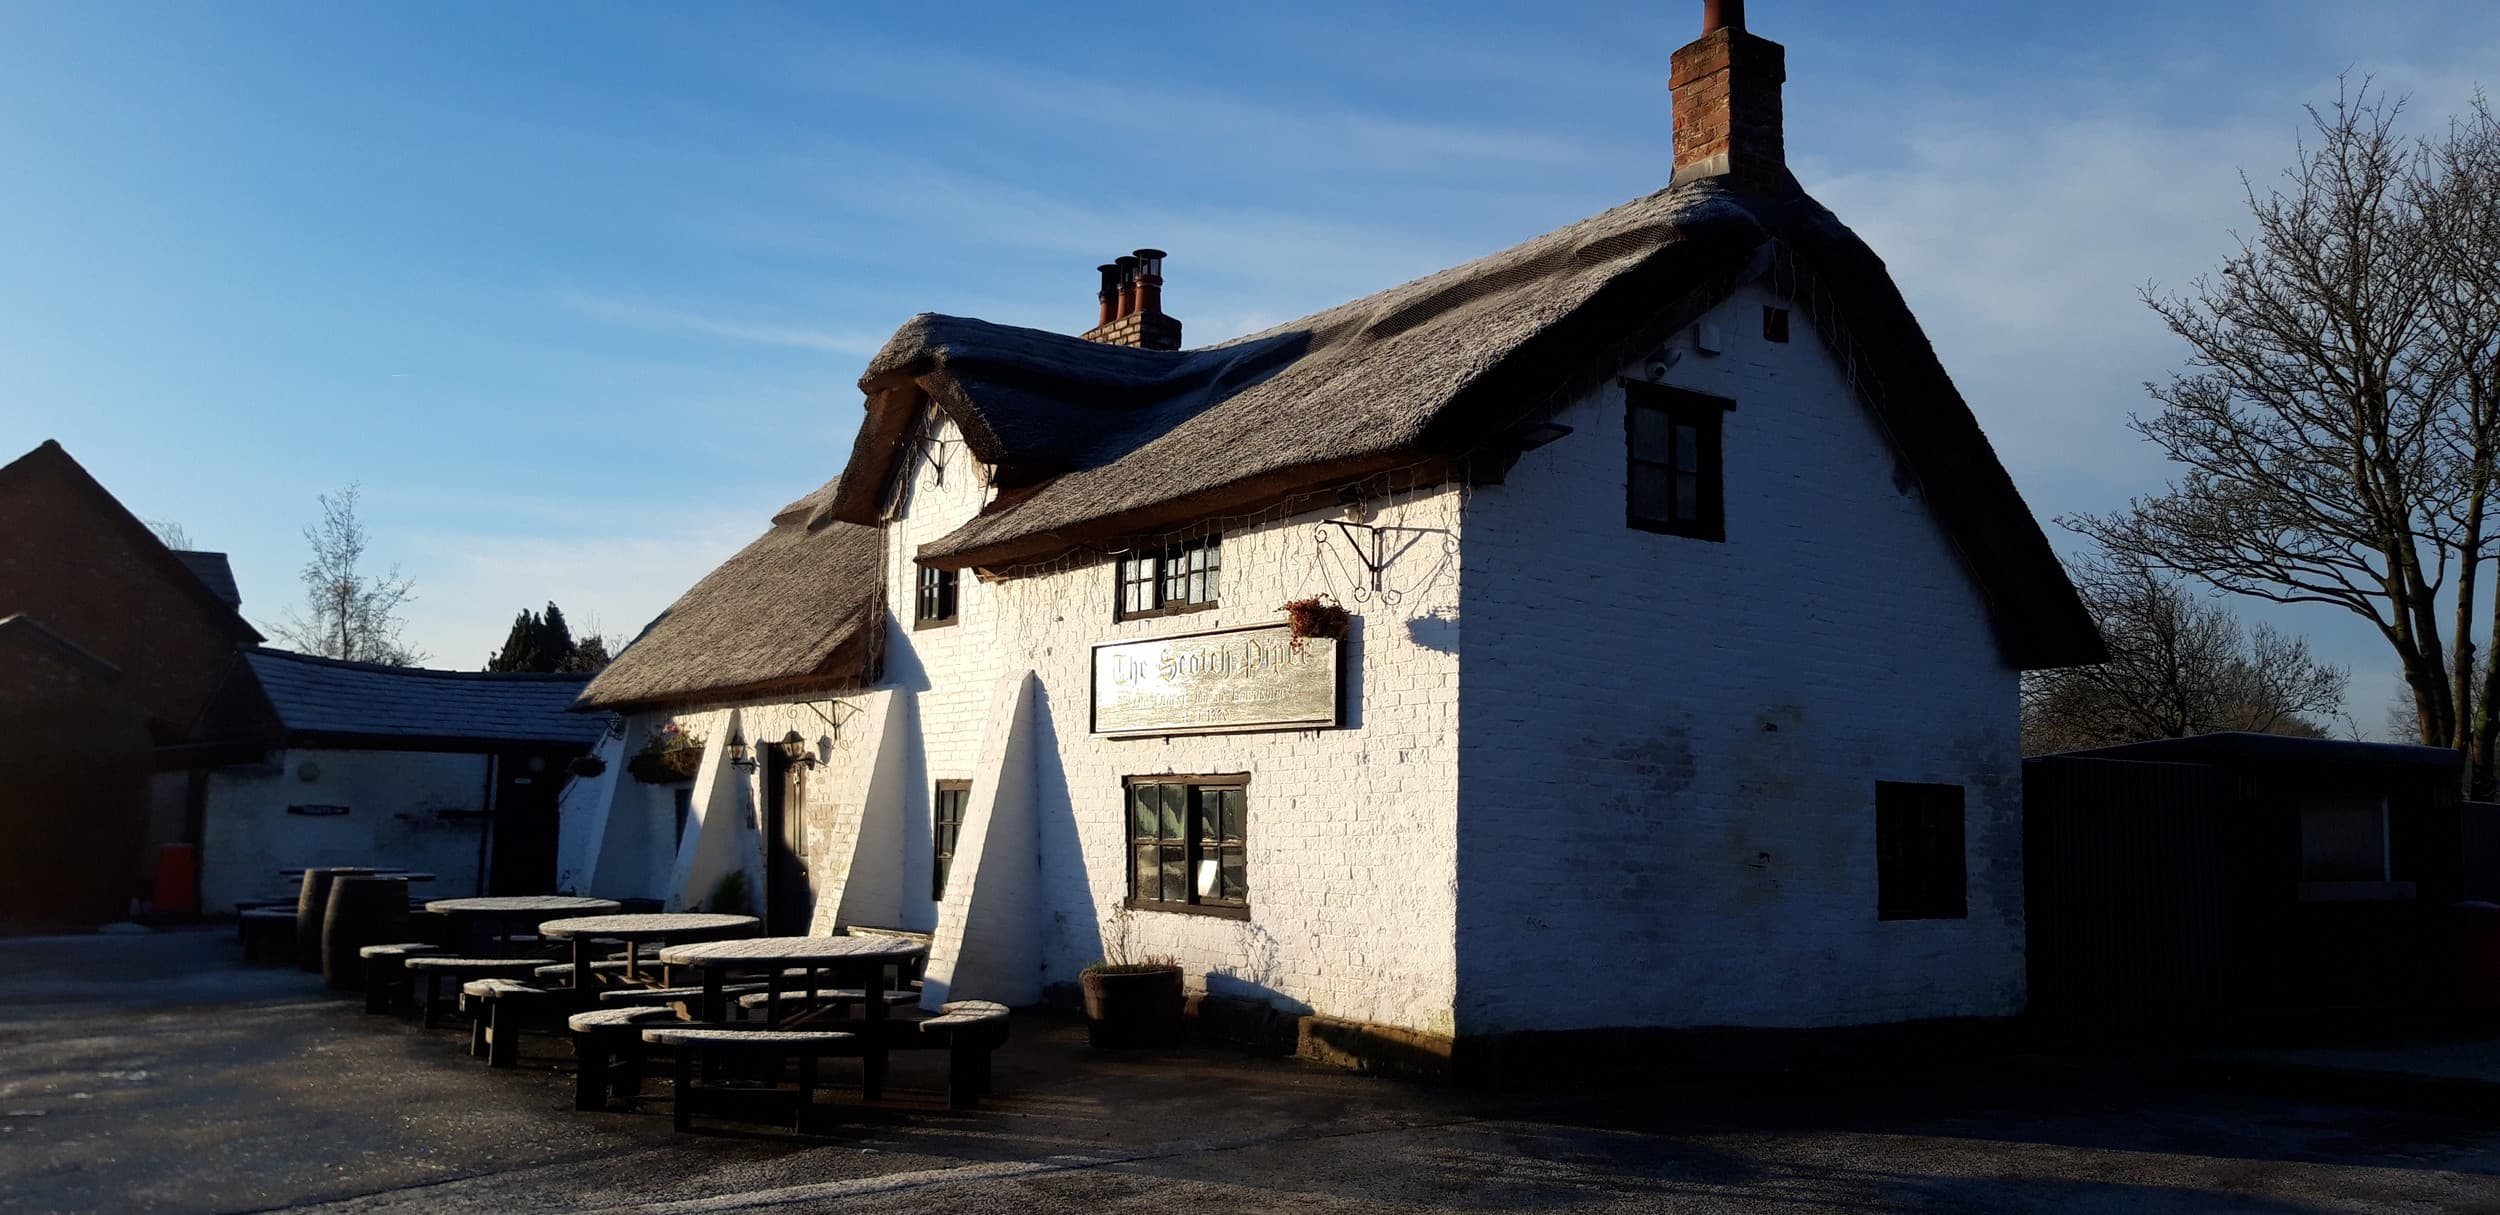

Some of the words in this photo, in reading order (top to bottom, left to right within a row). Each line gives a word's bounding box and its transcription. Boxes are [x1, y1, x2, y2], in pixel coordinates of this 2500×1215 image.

[1113, 654, 1148, 686] The
[1157, 645, 1232, 682] Scotch
[1240, 638, 1312, 679] Piper
